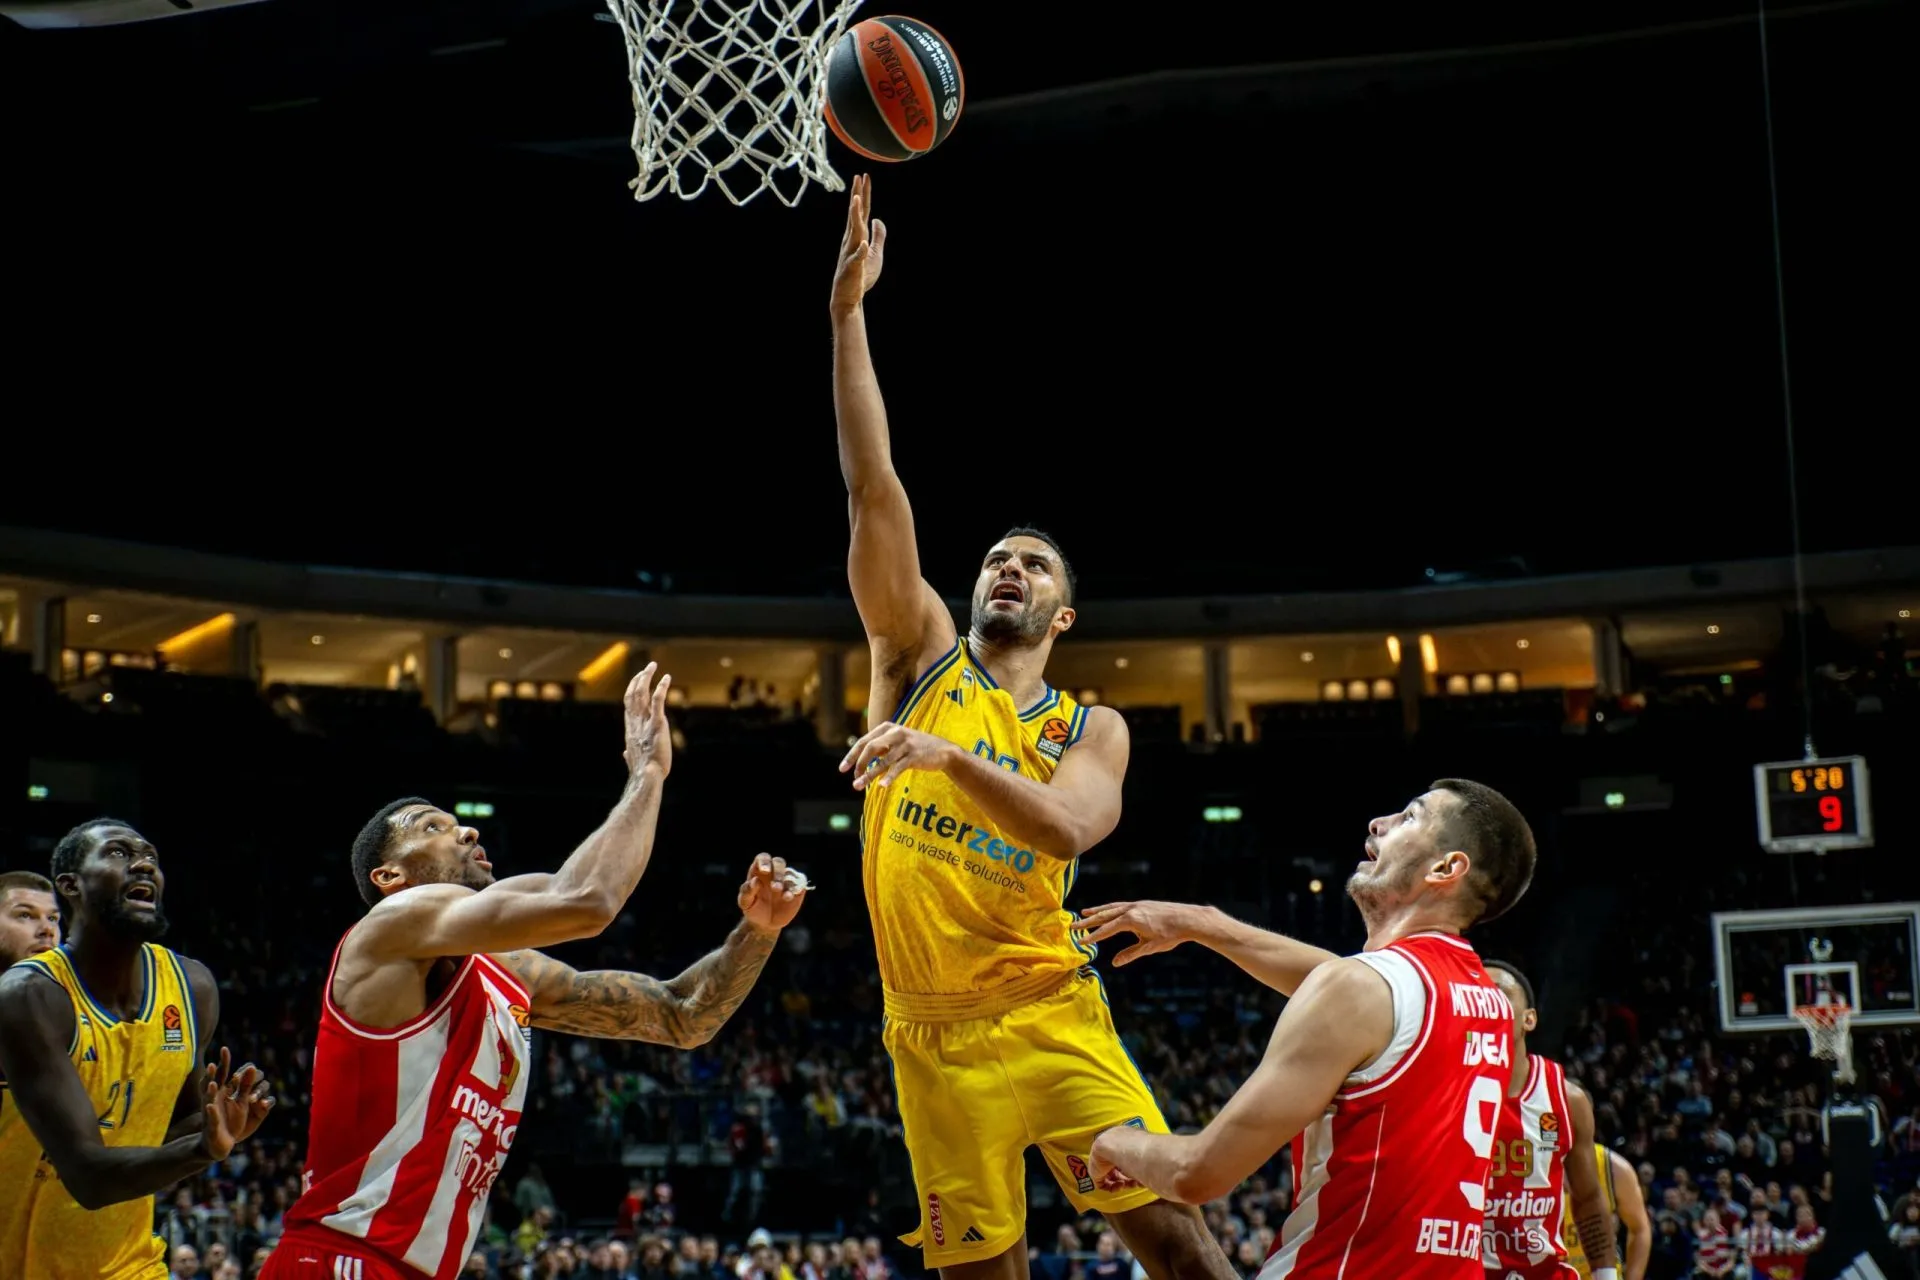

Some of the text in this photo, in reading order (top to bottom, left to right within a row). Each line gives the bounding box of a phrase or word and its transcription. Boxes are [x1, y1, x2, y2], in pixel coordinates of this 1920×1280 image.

[867, 32, 929, 134] SPALDING
[930, 52, 950, 96] TURKISH
[896, 786, 1035, 873] interzero
[1819, 796, 1843, 832] 9
[889, 828, 1026, 894] zero waste solutions
[98, 1080, 136, 1129] 21
[929, 1199, 945, 1241] GAZI
[1481, 1227, 1545, 1254] mts
